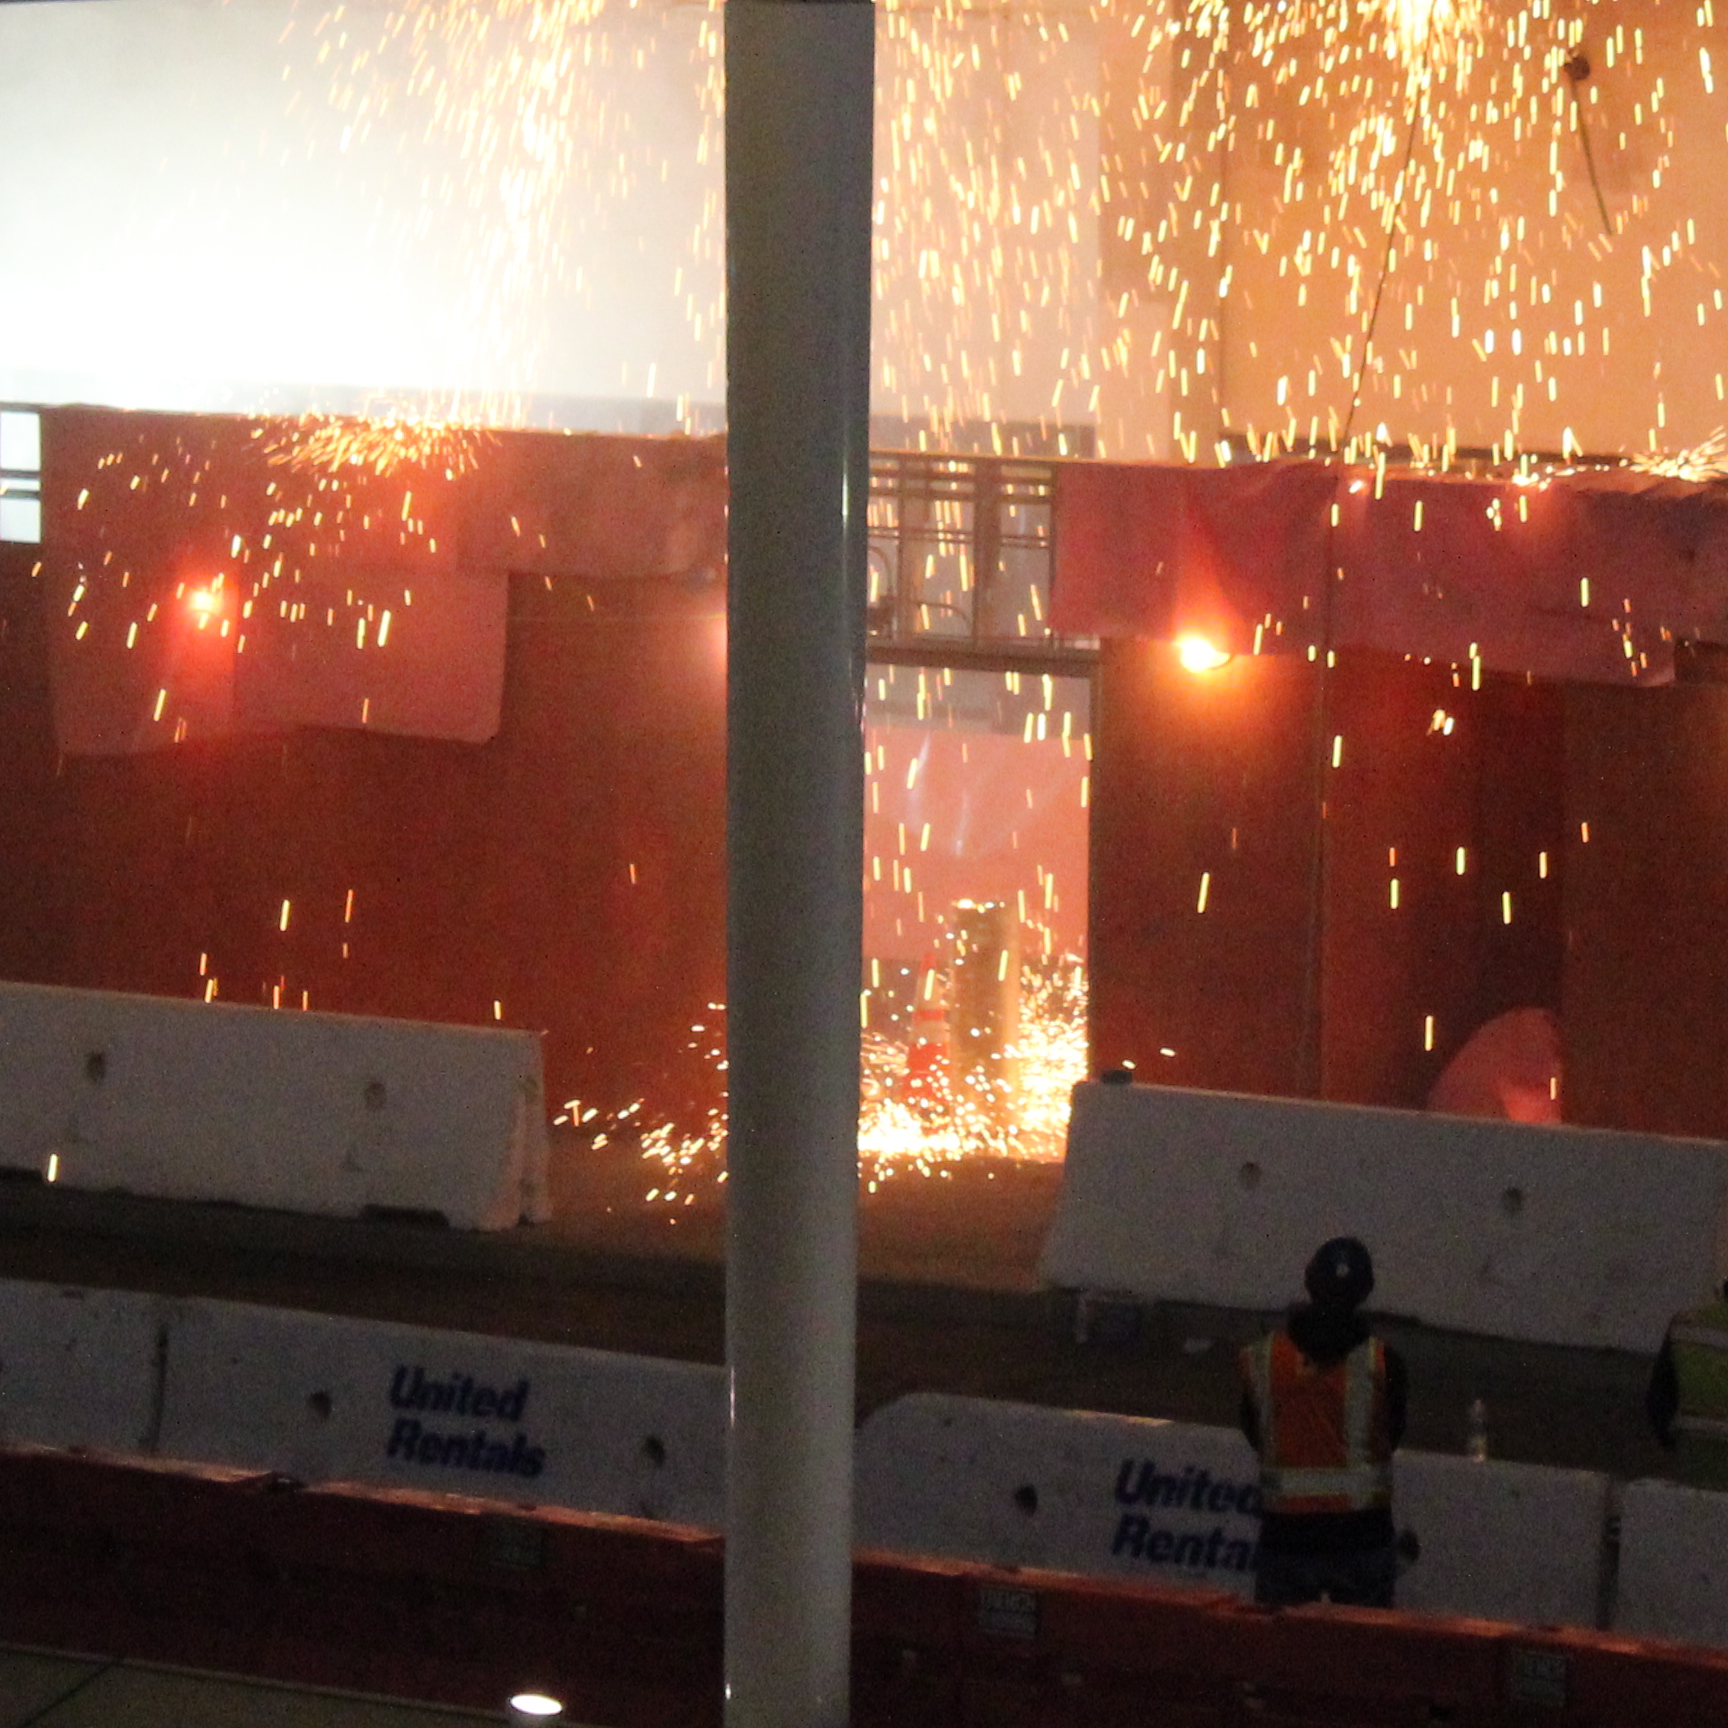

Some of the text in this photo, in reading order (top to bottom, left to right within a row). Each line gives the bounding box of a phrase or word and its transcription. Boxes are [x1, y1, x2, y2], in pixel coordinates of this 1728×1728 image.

[390, 1366, 530, 1421] United
[387, 1419, 546, 1478] Rentals
[1113, 1514, 1252, 1571] Renta
